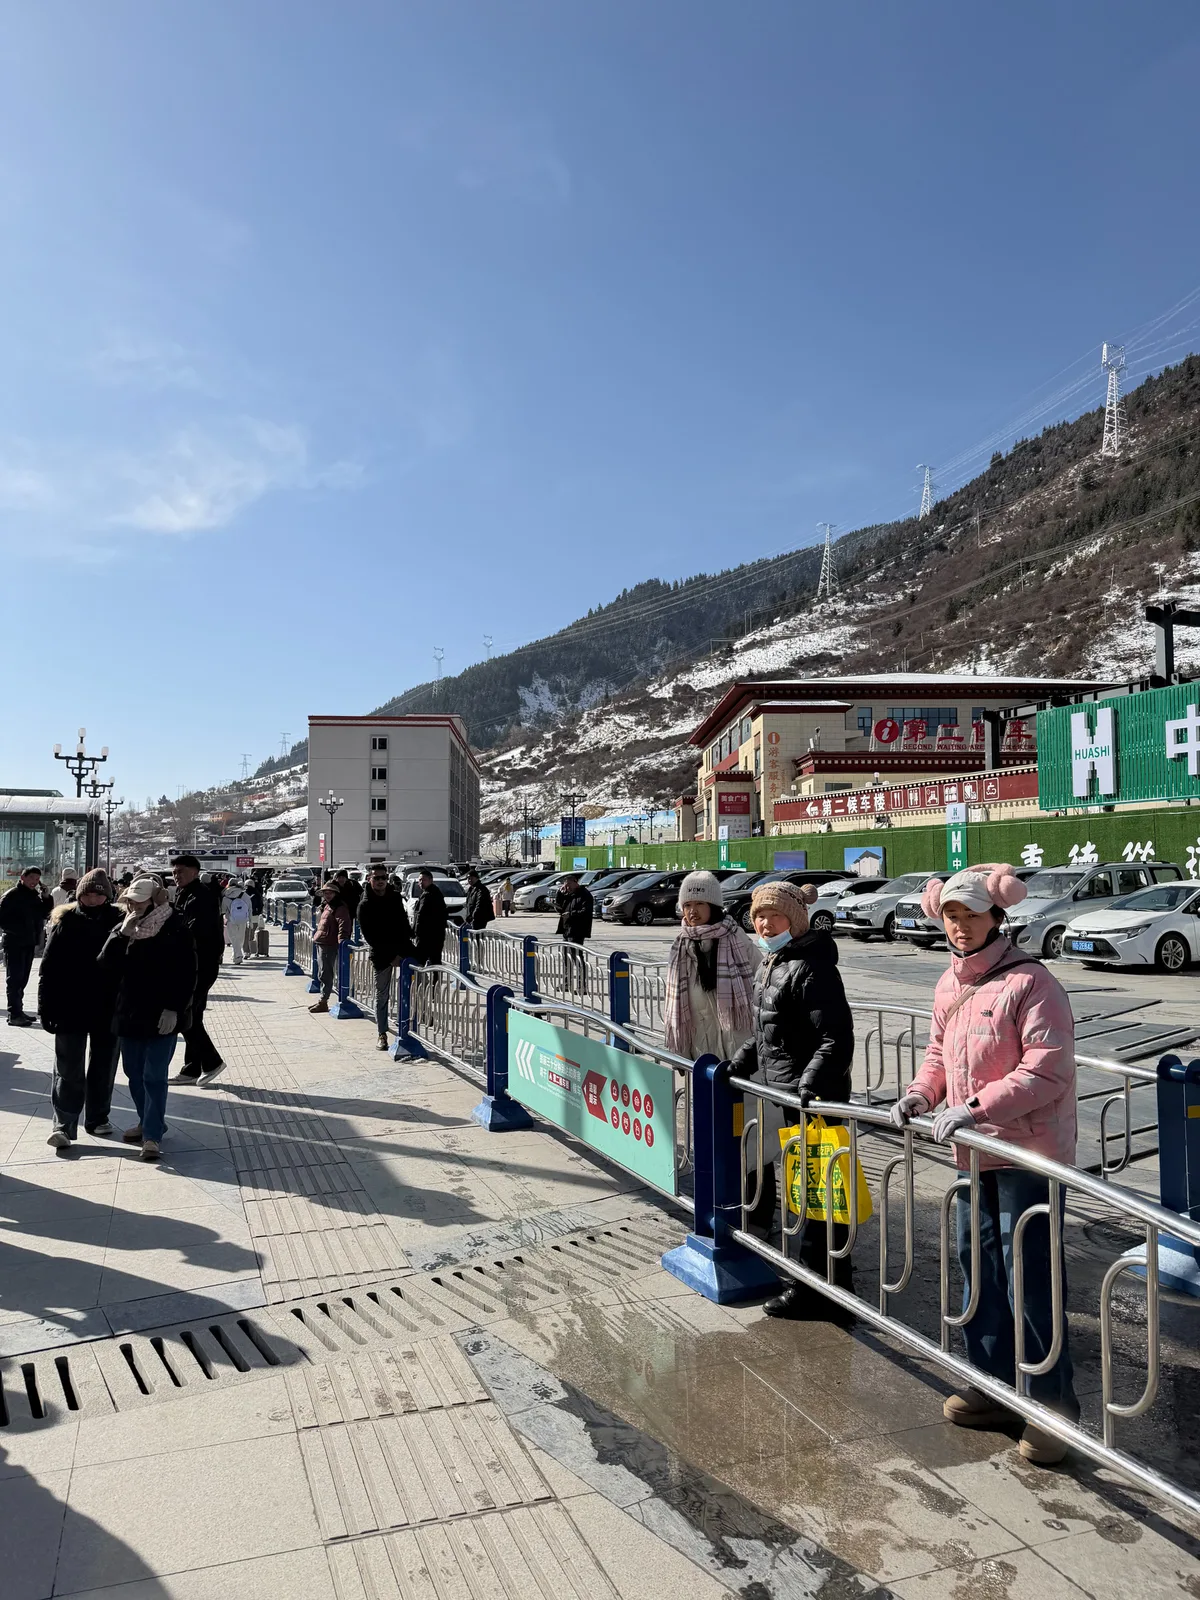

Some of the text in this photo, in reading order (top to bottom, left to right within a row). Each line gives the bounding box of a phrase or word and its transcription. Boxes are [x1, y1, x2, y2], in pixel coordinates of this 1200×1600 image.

[1074, 745, 1110, 761] HUASHI
[821, 792, 886, 817] 第二候车楼
[952, 857, 962, 870] 中
